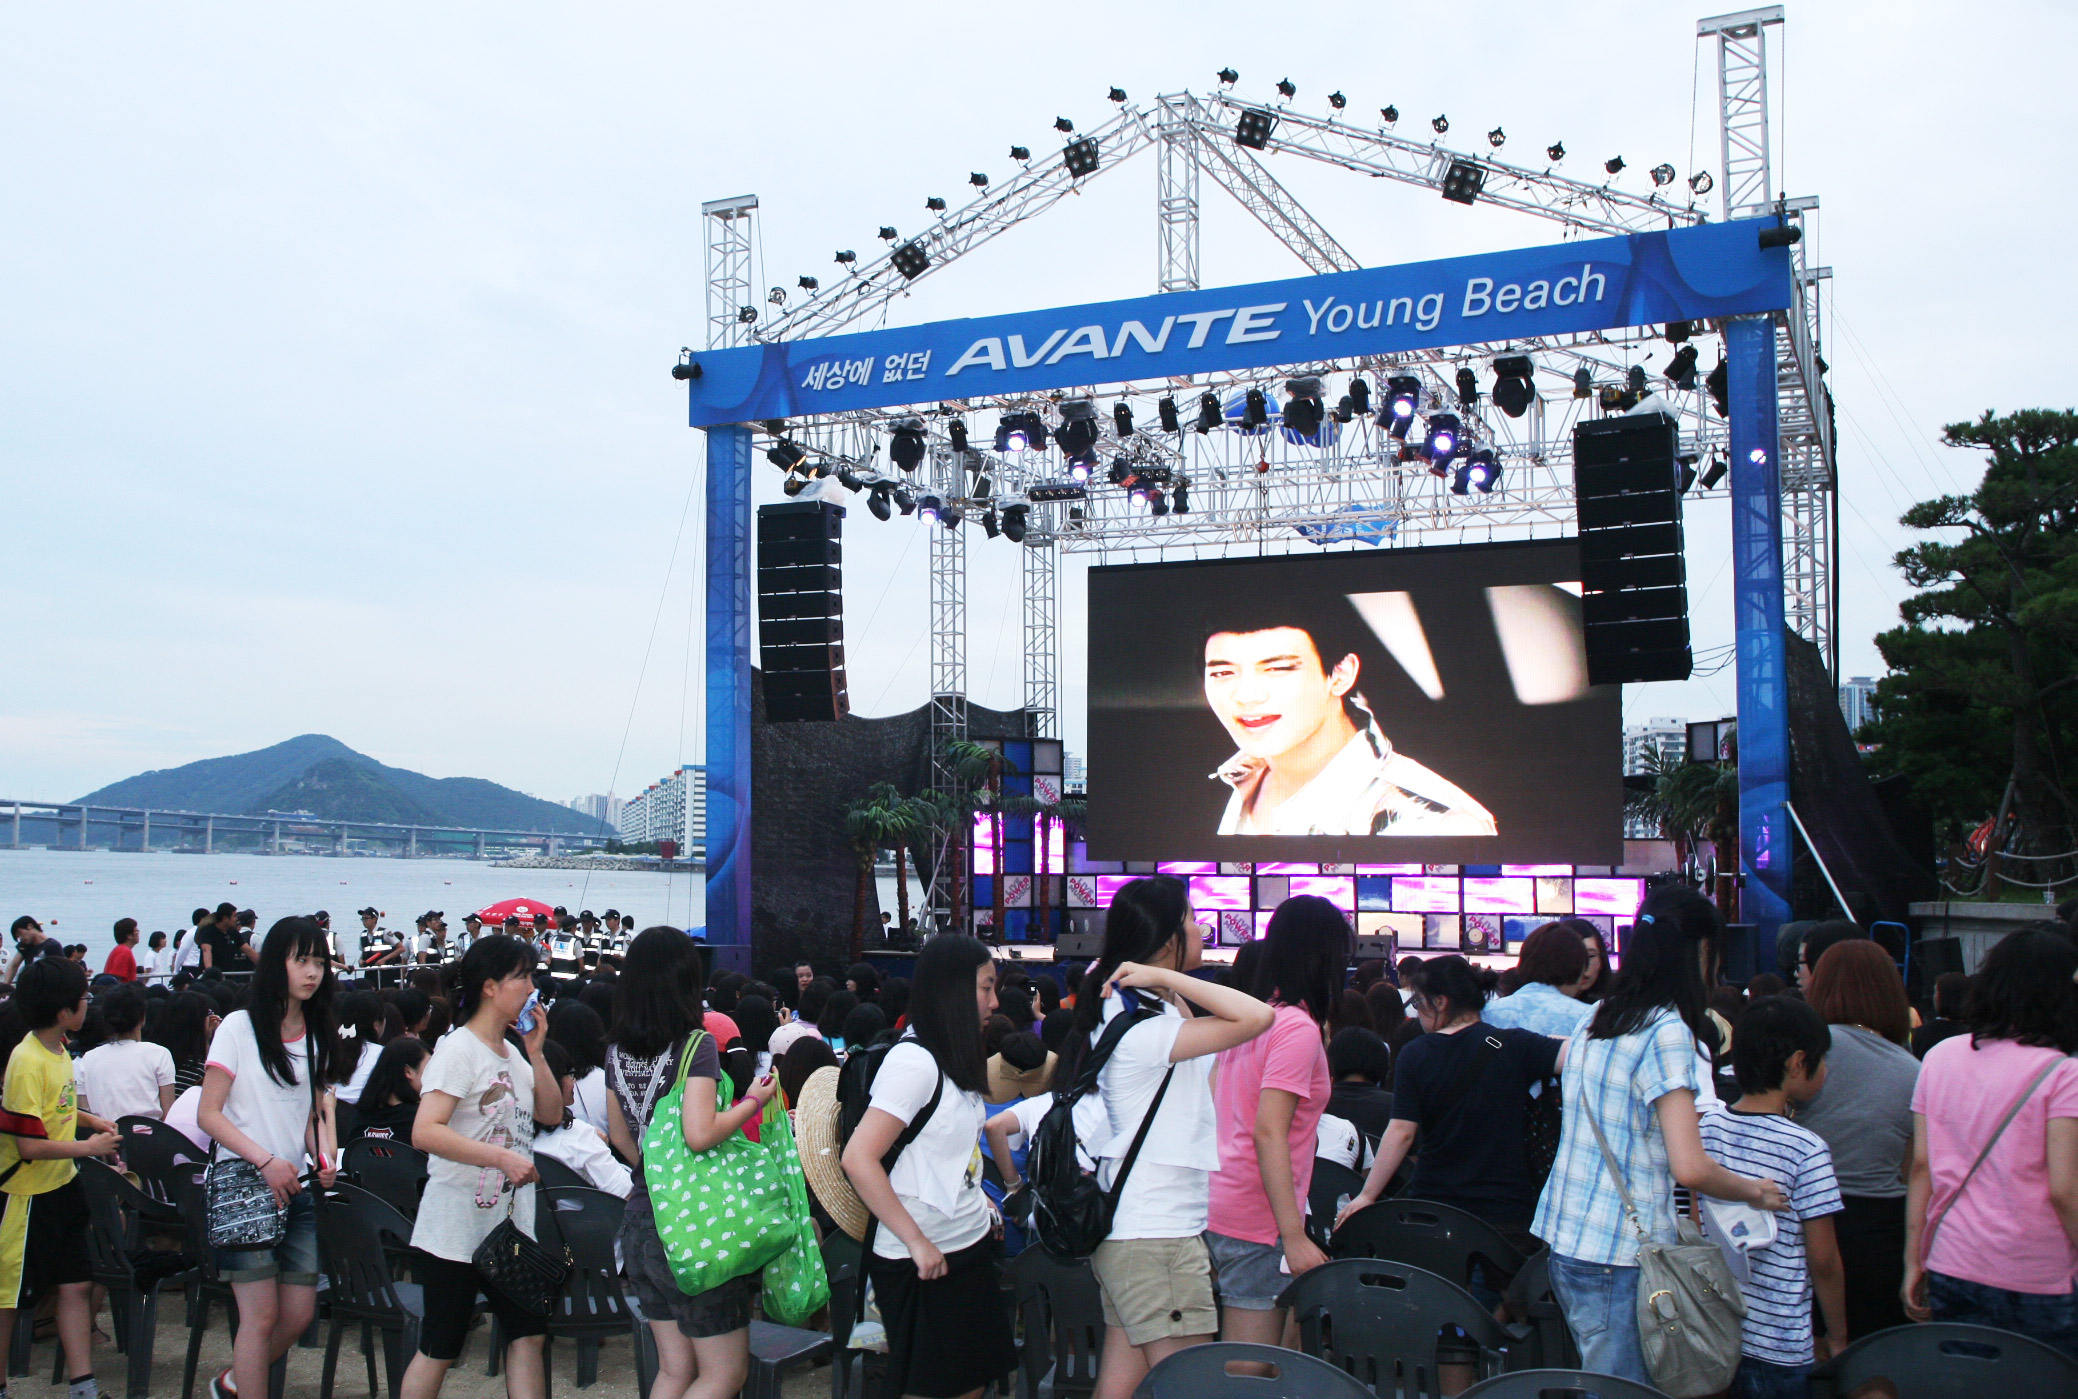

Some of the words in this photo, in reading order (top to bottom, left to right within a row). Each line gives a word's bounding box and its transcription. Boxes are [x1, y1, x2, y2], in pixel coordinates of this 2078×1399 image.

[802, 357, 874, 390] 세상에
[883, 350, 931, 384] 없던
[946, 303, 1287, 376] AVANTE
[1304, 294, 1443, 335] Young
[1463, 265, 1605, 317] Beach
[1034, 777, 1060, 804] POWER
[1042, 777, 1060, 794] LIVE
[1005, 876, 1022, 896] LIVE
[1005, 876, 1030, 905] POWER
[1010, 883, 1031, 906] MUSIC
[1068, 884, 1091, 907] MUSIC
[1069, 877, 1095, 905] POWER
[1077, 877, 1095, 896] LIVE
[1223, 920, 1246, 944] MUSIC
[1224, 913, 1252, 941] POWER
[1233, 913, 1252, 931] LIVE
[1478, 916, 1499, 934] LIVE
